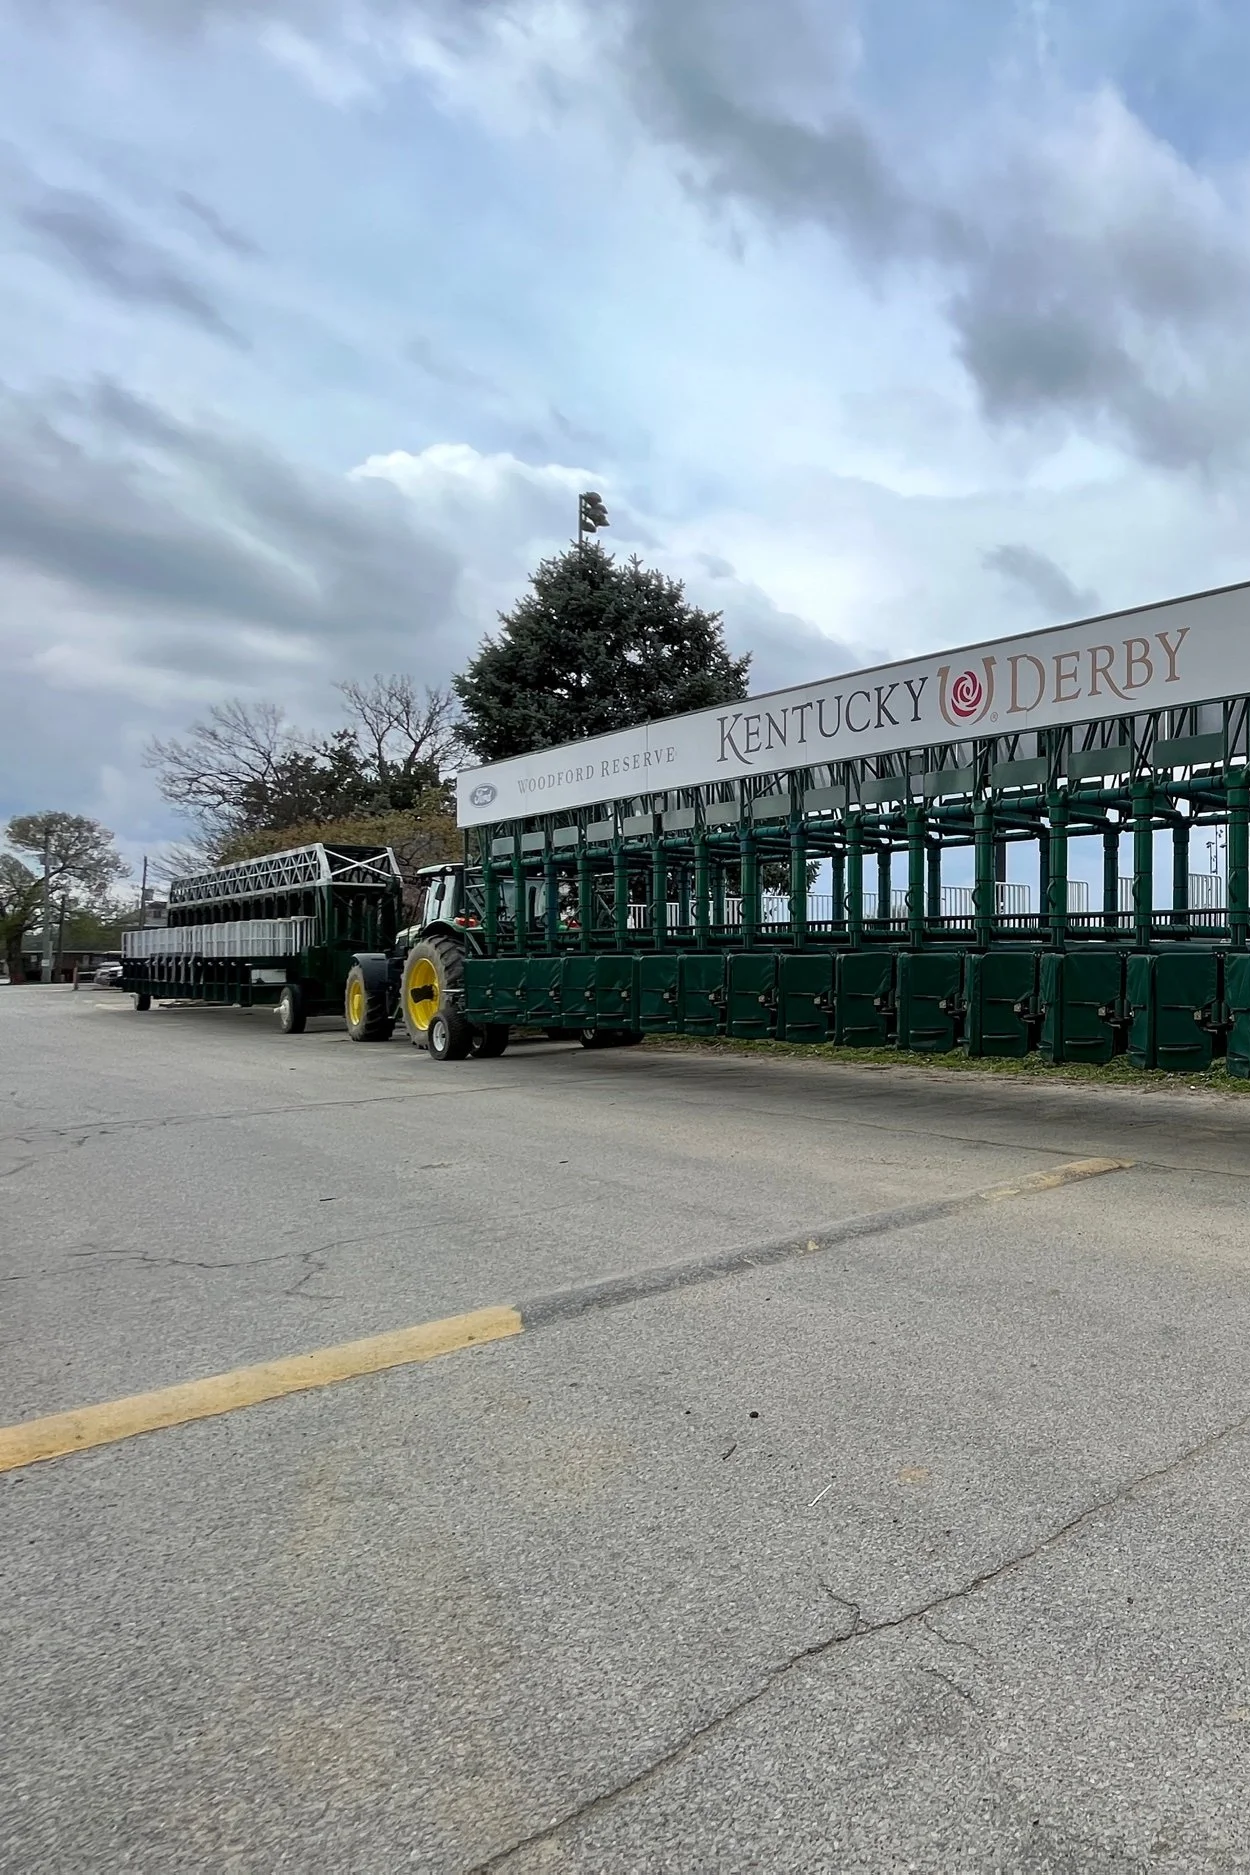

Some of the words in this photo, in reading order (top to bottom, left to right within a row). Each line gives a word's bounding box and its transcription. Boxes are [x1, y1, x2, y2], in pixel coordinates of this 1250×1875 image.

[716, 676, 929, 765] KENTUCKY
[1007, 627, 1191, 714] DERBY
[517, 765, 594, 794] WOODFORD
[601, 747, 676, 777] RESERVE
